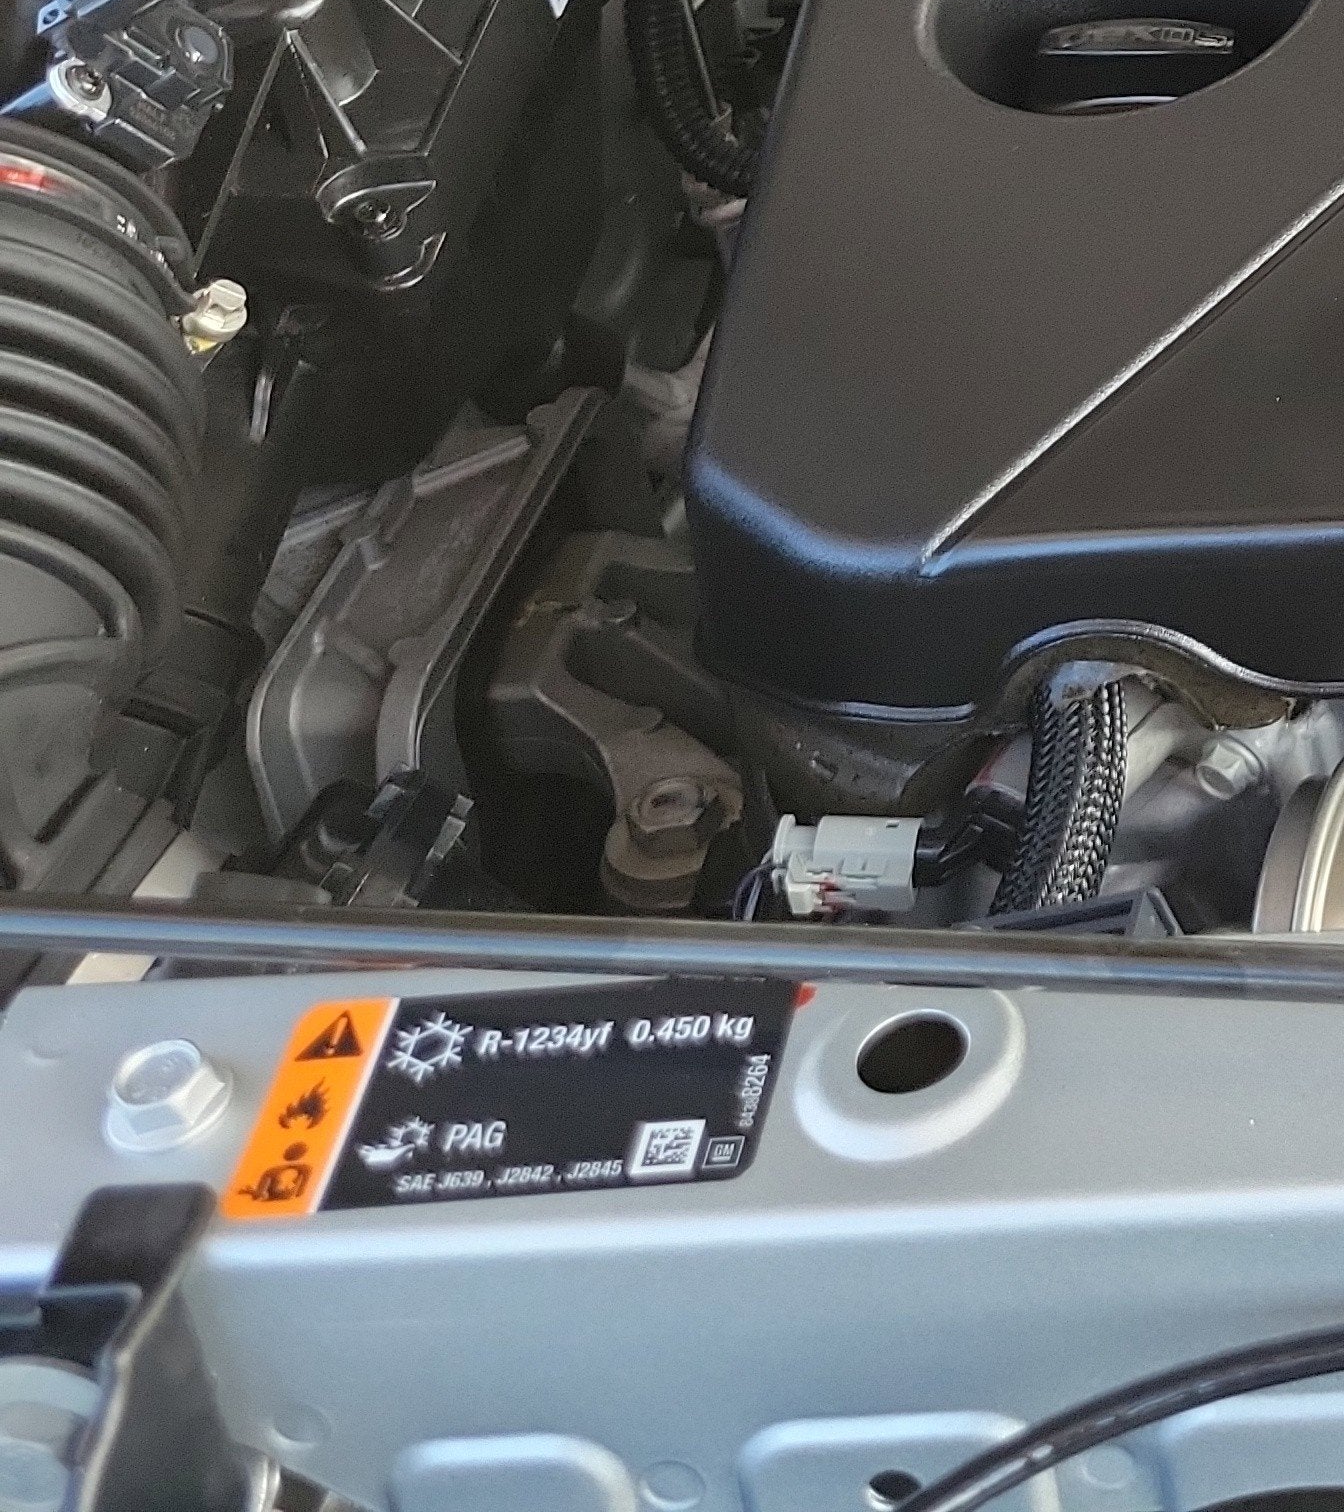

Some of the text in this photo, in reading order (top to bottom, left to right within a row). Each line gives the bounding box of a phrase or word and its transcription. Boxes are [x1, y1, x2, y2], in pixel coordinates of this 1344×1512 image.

[478, 1013, 755, 1056] R-1234yf 0.450 kg
[444, 1121, 507, 1152] PAG
[398, 1172, 436, 1192] SAE
[567, 1159, 624, 1180] J2845
